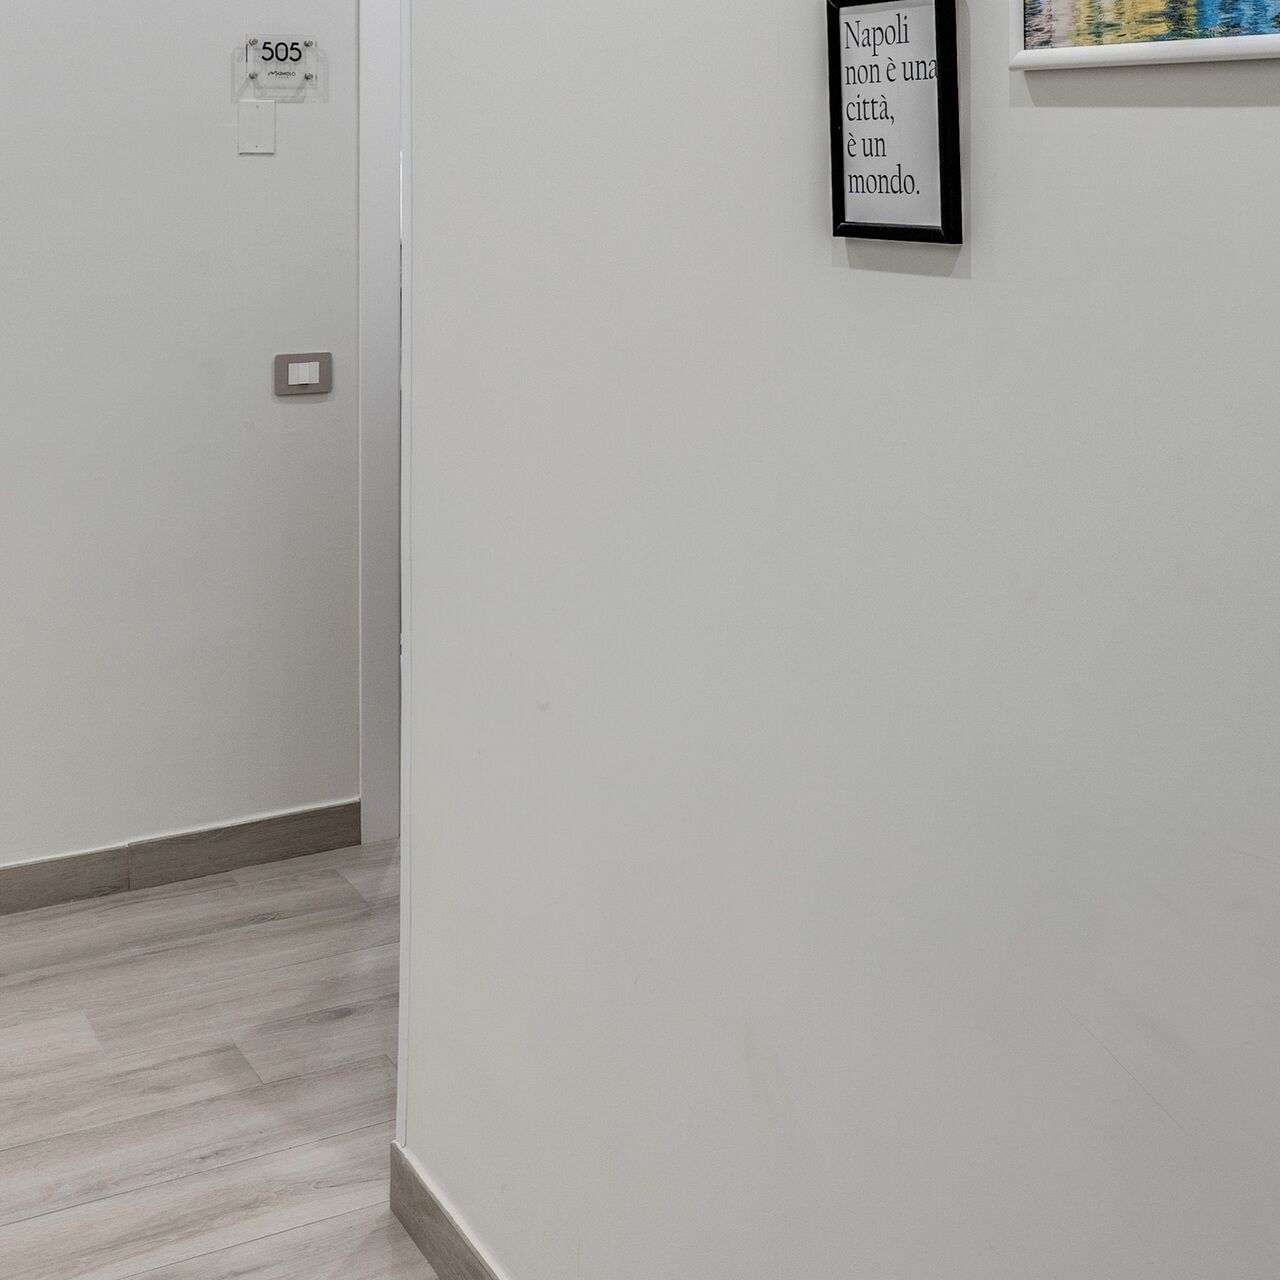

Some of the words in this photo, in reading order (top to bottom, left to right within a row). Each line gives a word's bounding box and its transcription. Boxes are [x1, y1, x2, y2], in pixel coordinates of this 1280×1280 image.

[844, 13, 910, 57] Napoli
[262, 42, 301, 61] 505
[845, 64, 881, 86] non
[886, 57, 896, 82] è
[902, 58, 938, 82] una
[846, 94, 895, 126] città,
[847, 133, 857, 158] è
[861, 137, 886, 158] un
[848, 163, 920, 195] mondo.
